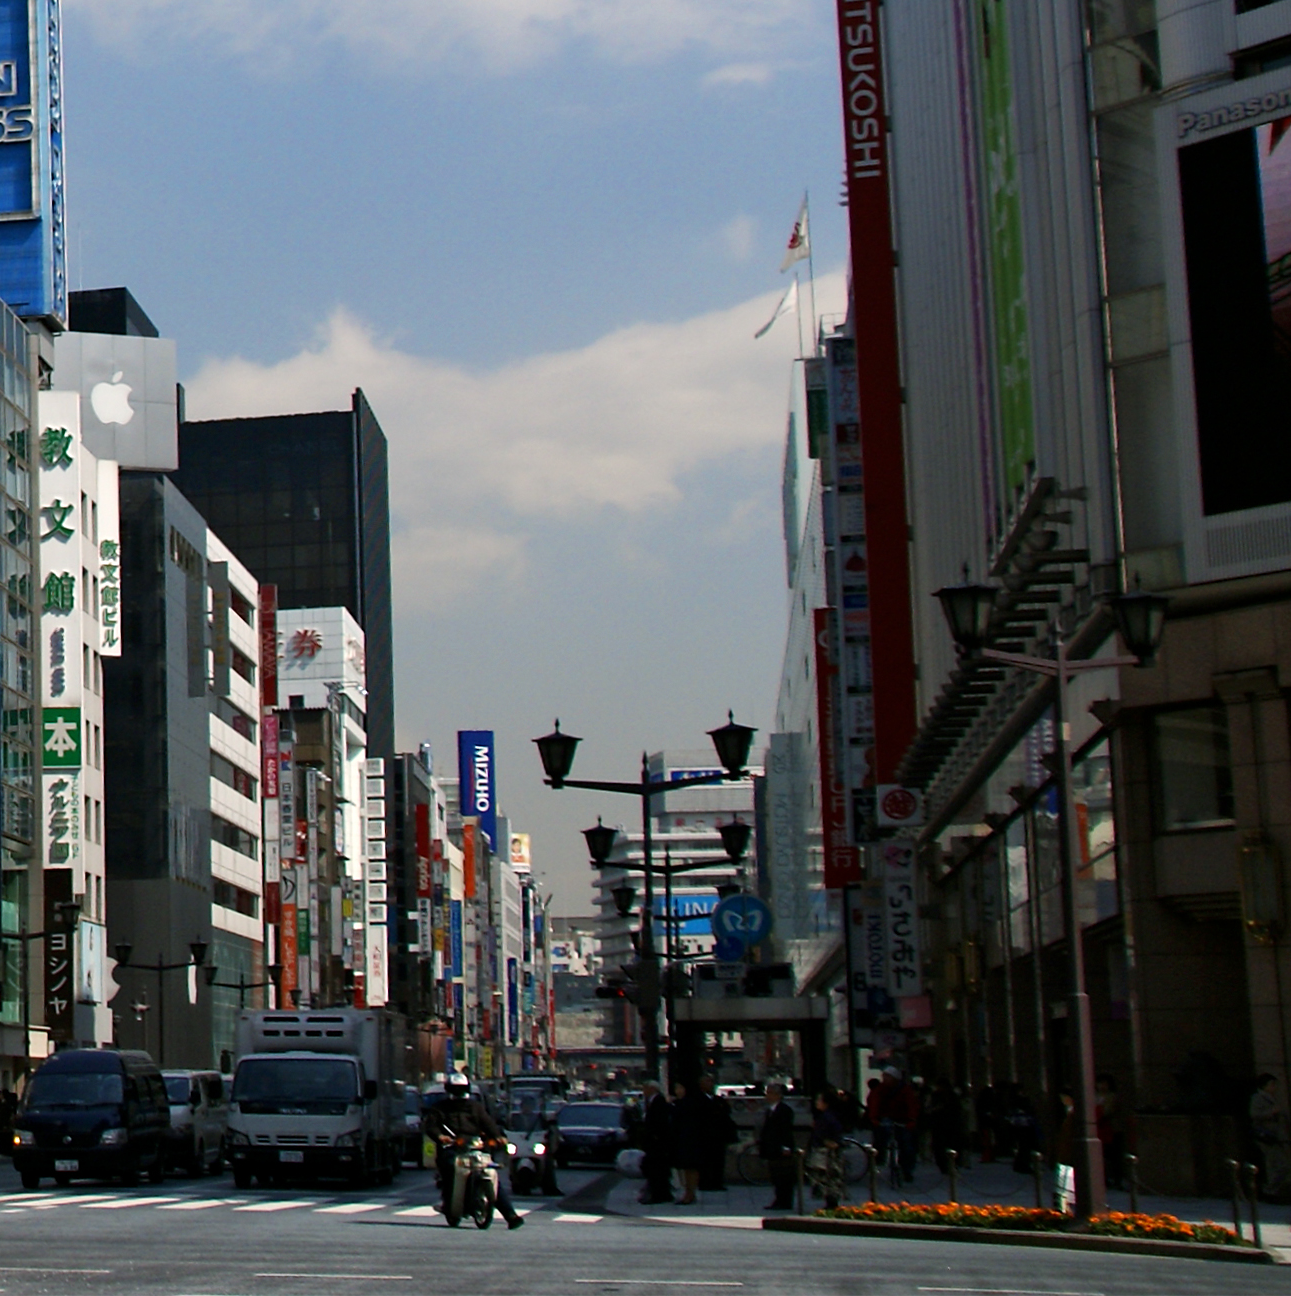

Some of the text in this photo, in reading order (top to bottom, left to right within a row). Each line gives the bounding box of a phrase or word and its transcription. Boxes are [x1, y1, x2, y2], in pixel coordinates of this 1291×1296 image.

[40, 426, 76, 612] 教文館
[44, 716, 77, 758] 本
[474, 745, 490, 812] MIZUHO
[49, 933, 68, 1015] ヨシノヤ
